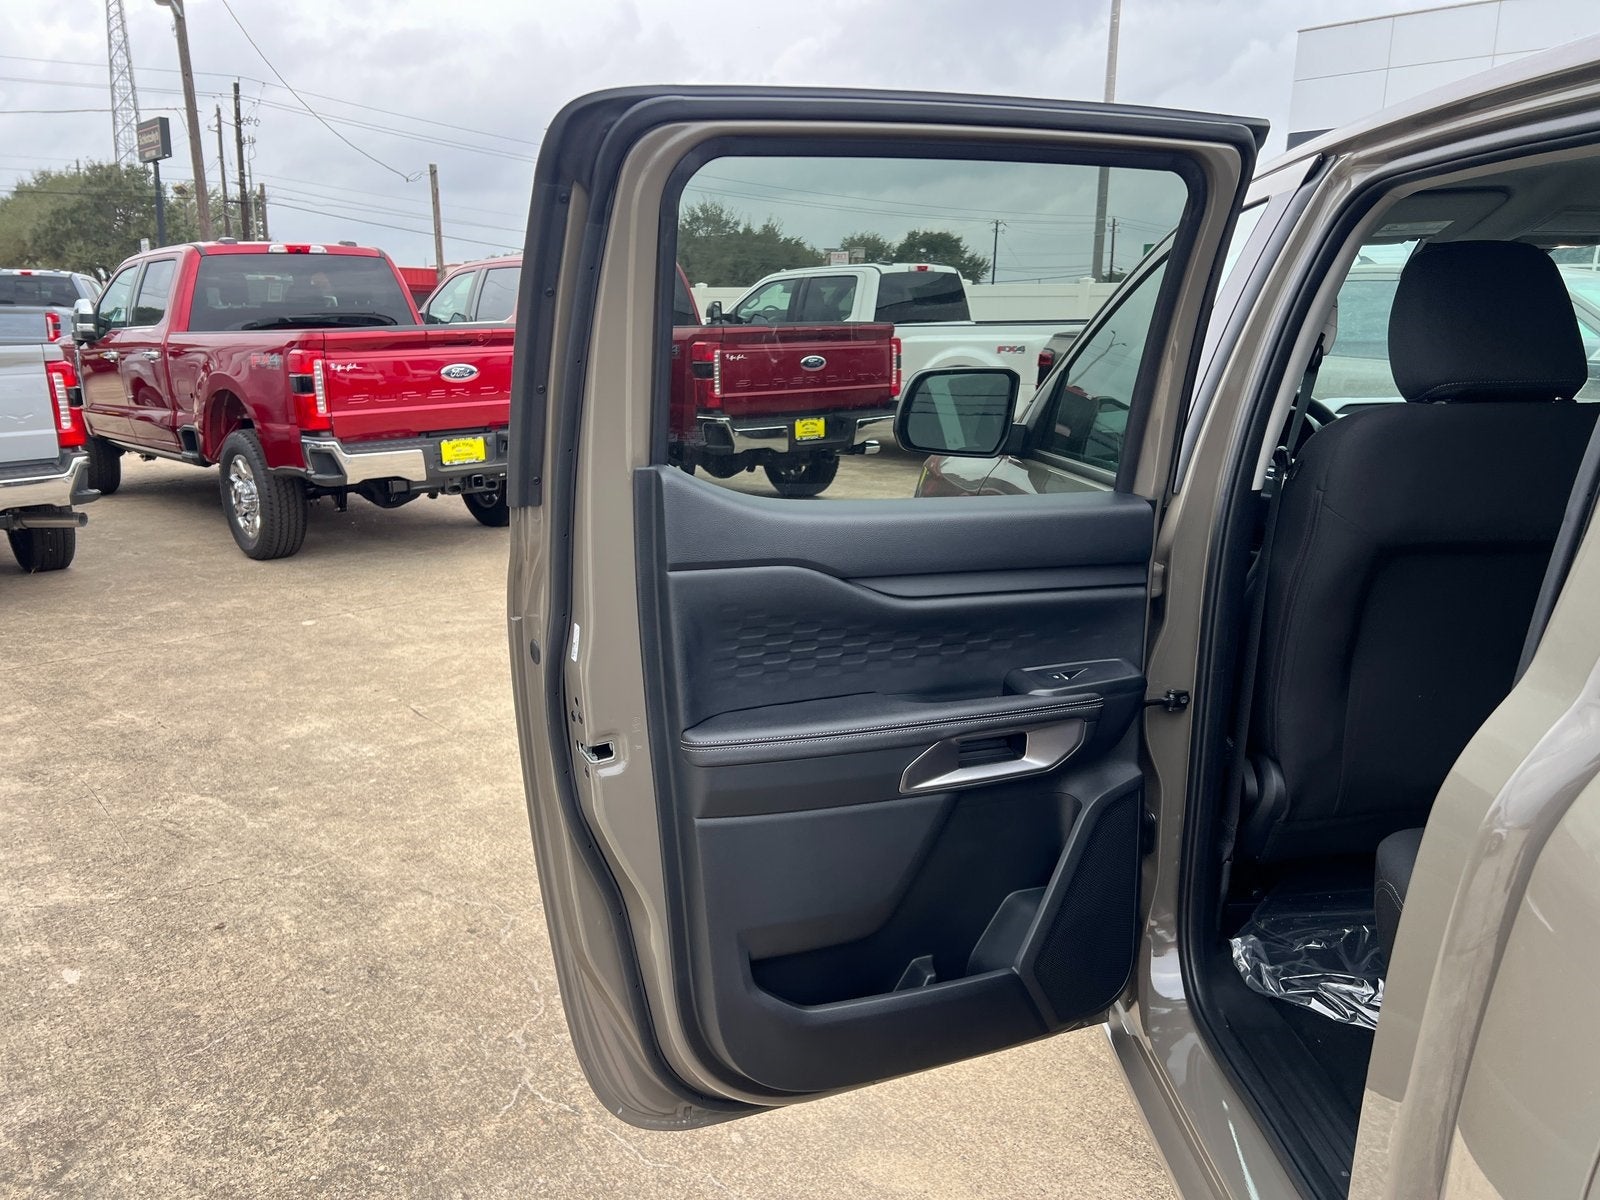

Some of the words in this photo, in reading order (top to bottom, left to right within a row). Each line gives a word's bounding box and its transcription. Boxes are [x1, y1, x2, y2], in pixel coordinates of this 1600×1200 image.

[997, 345, 1025, 354] FX4
[251, 352, 280, 368] FX4
[450, 367, 470, 378] Ford
[735, 376, 820, 388] SUPER
[825, 372, 882, 383] DUTY
[348, 387, 470, 404] SUPER
